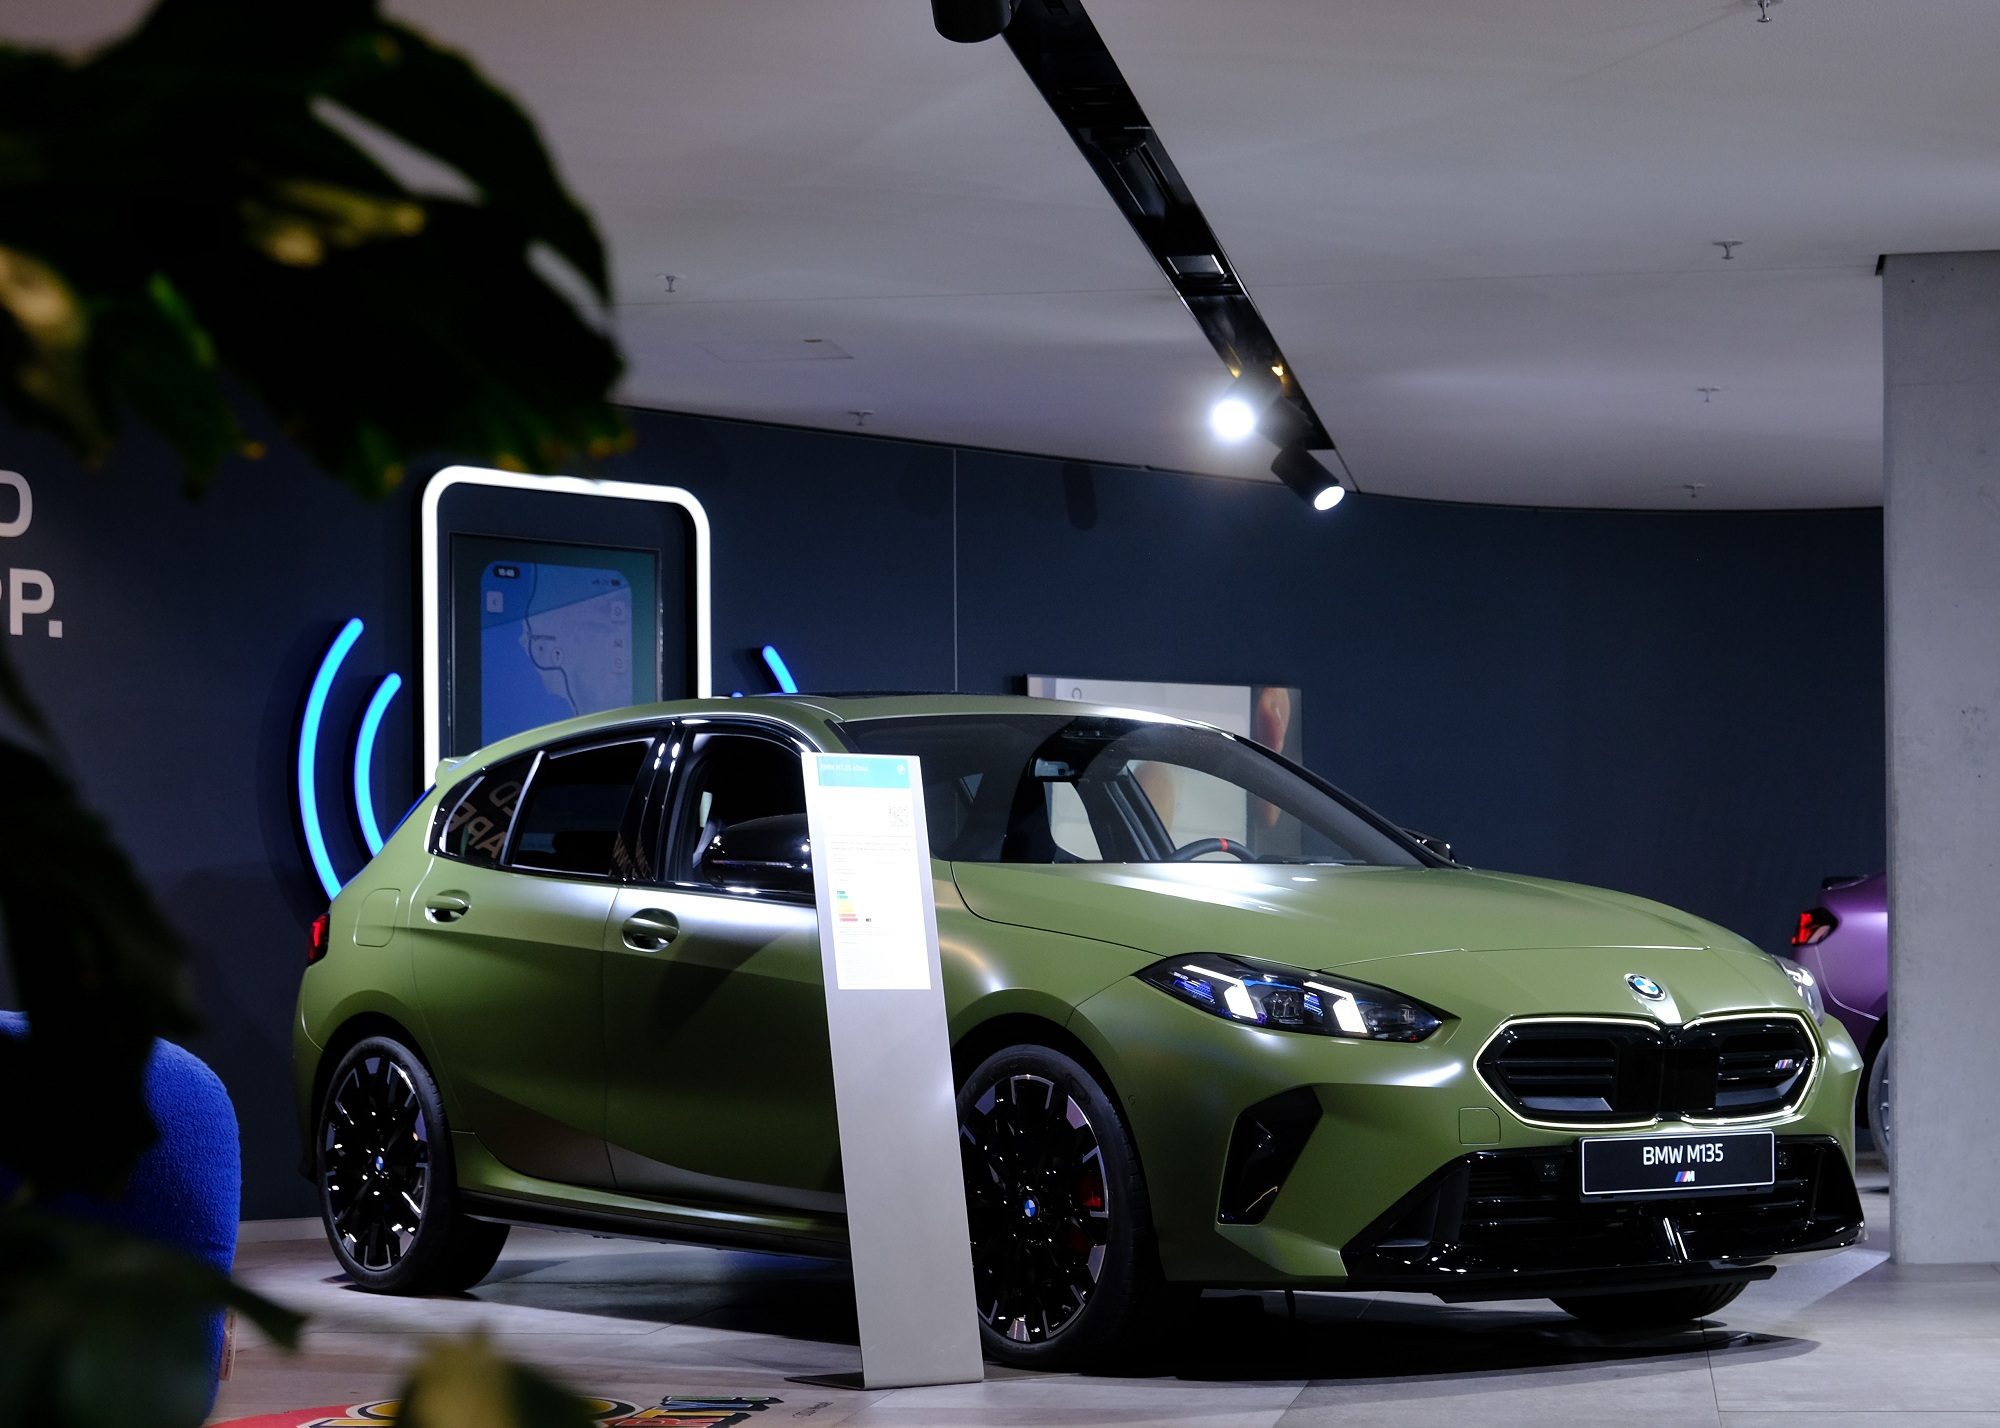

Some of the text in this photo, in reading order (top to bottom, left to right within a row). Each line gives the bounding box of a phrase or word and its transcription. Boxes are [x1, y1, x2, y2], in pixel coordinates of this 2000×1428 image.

[0, 568, 63, 638] P.
[1643, 1143, 1724, 1166] BMW M135
